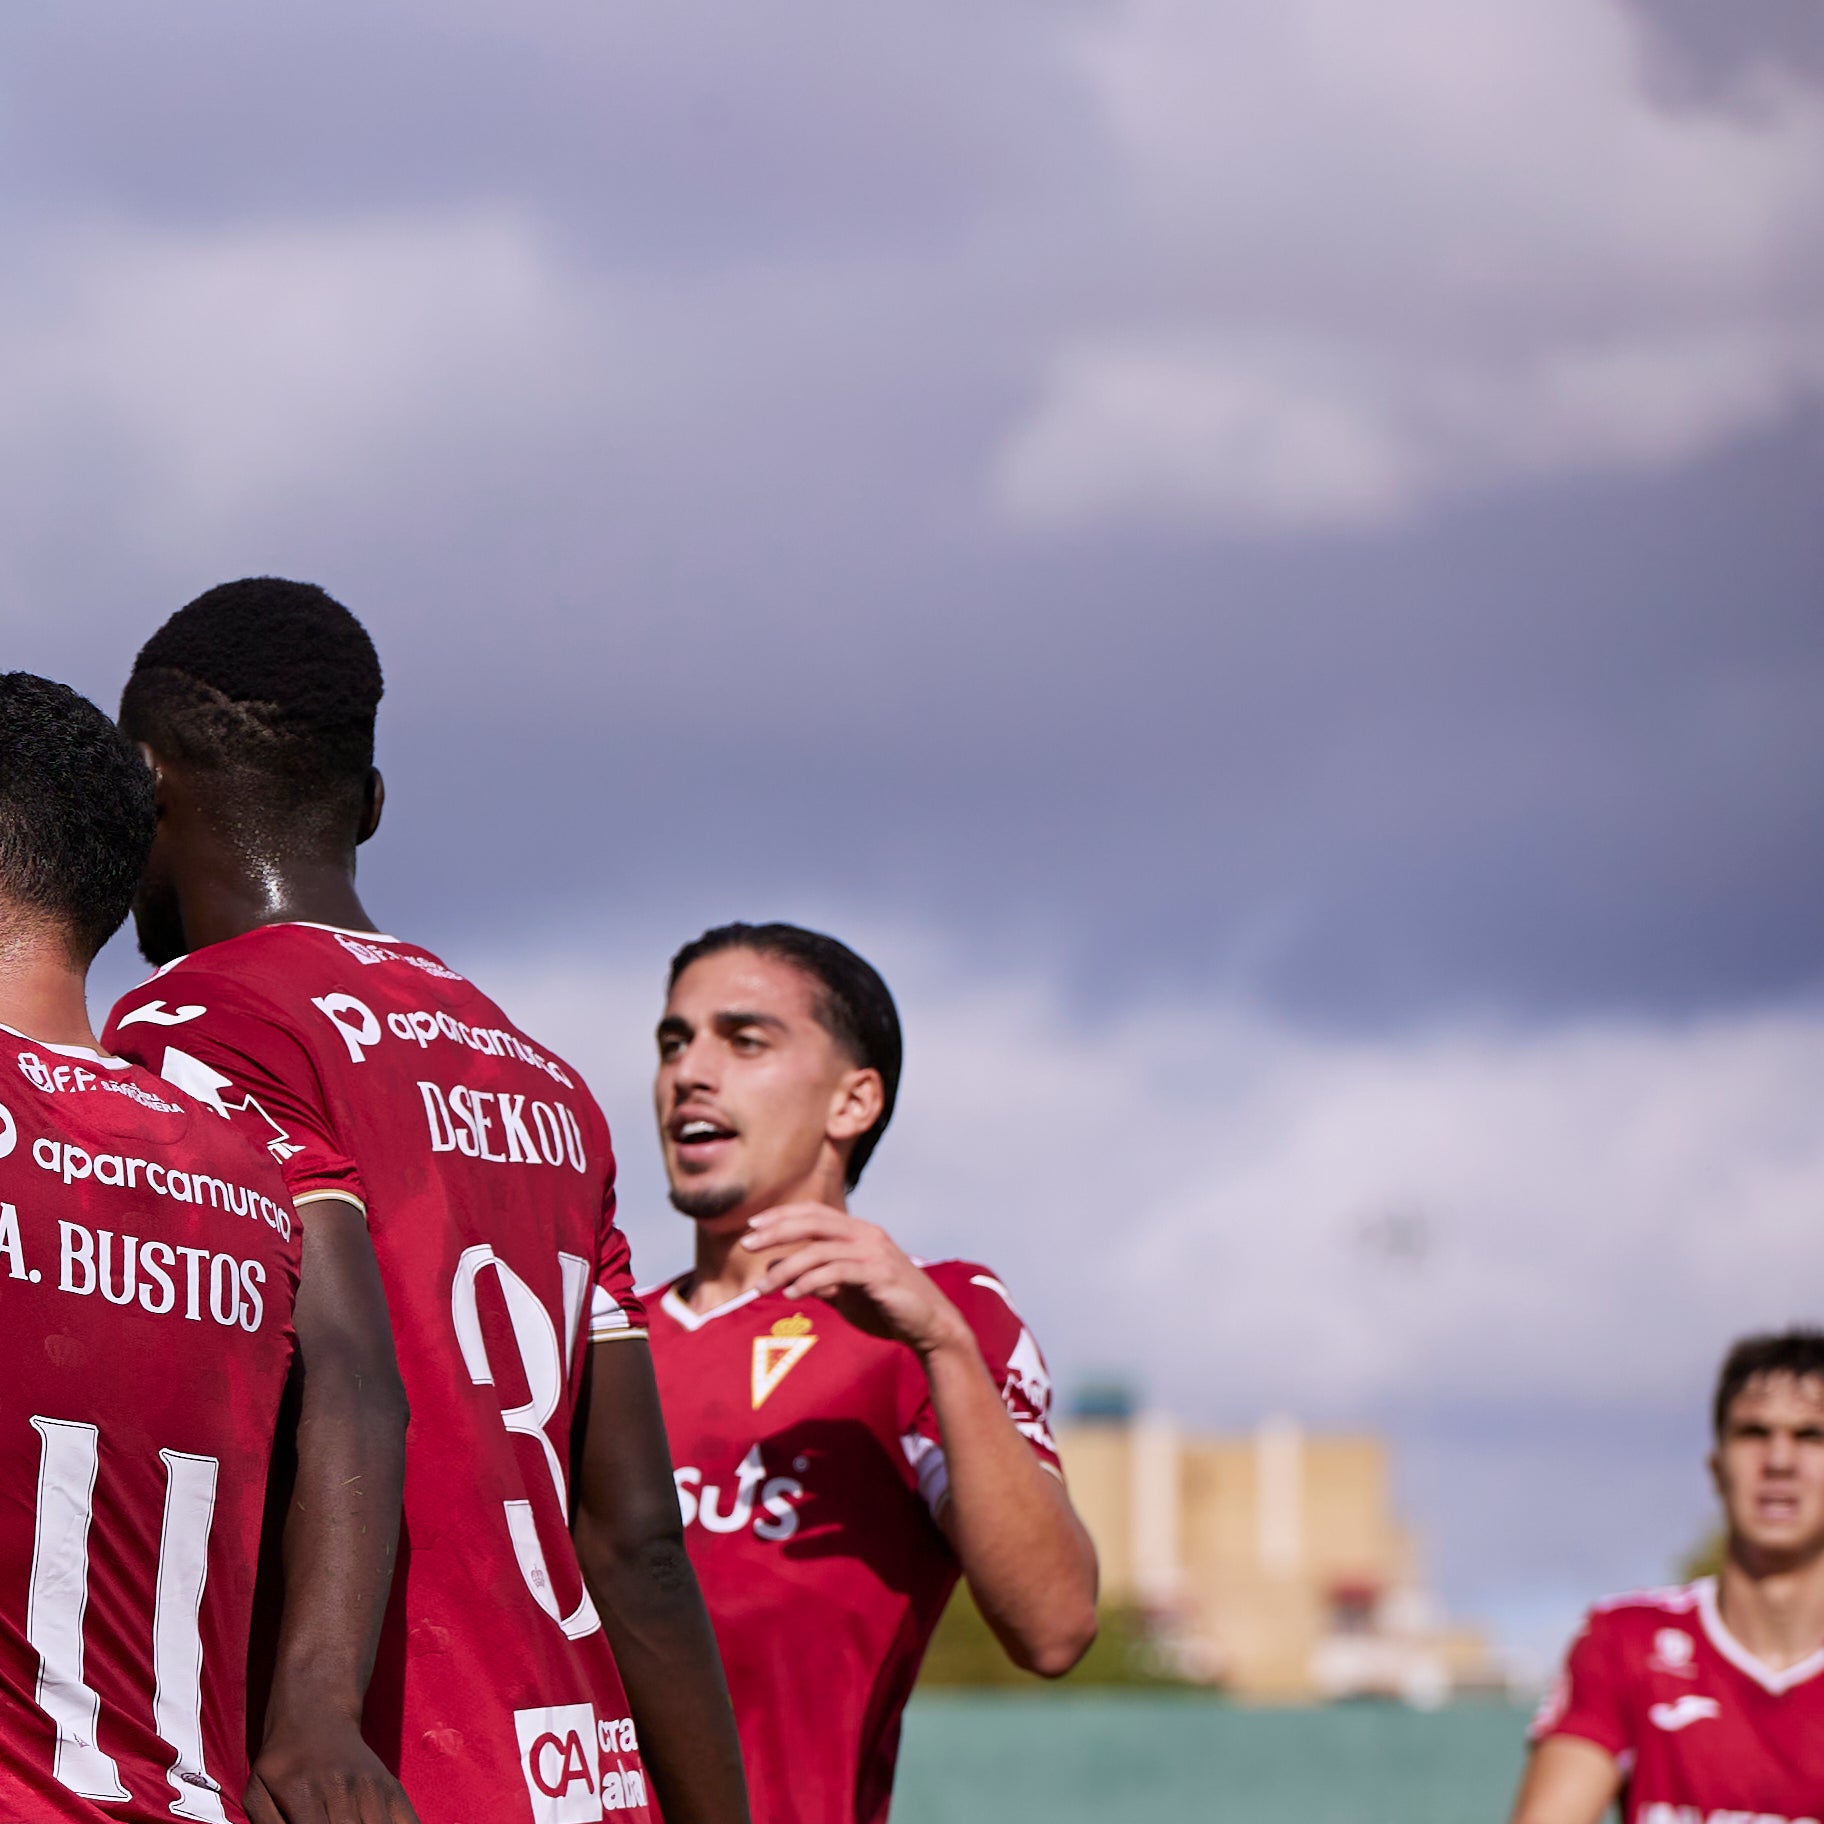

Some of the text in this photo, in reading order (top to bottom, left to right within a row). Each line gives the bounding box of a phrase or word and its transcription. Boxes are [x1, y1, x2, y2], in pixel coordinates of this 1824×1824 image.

[416, 1080, 587, 1174] DSEKOU
[32, 1137, 292, 1243] aparcamurcia
[57, 1219, 267, 1333] BUSTOS
